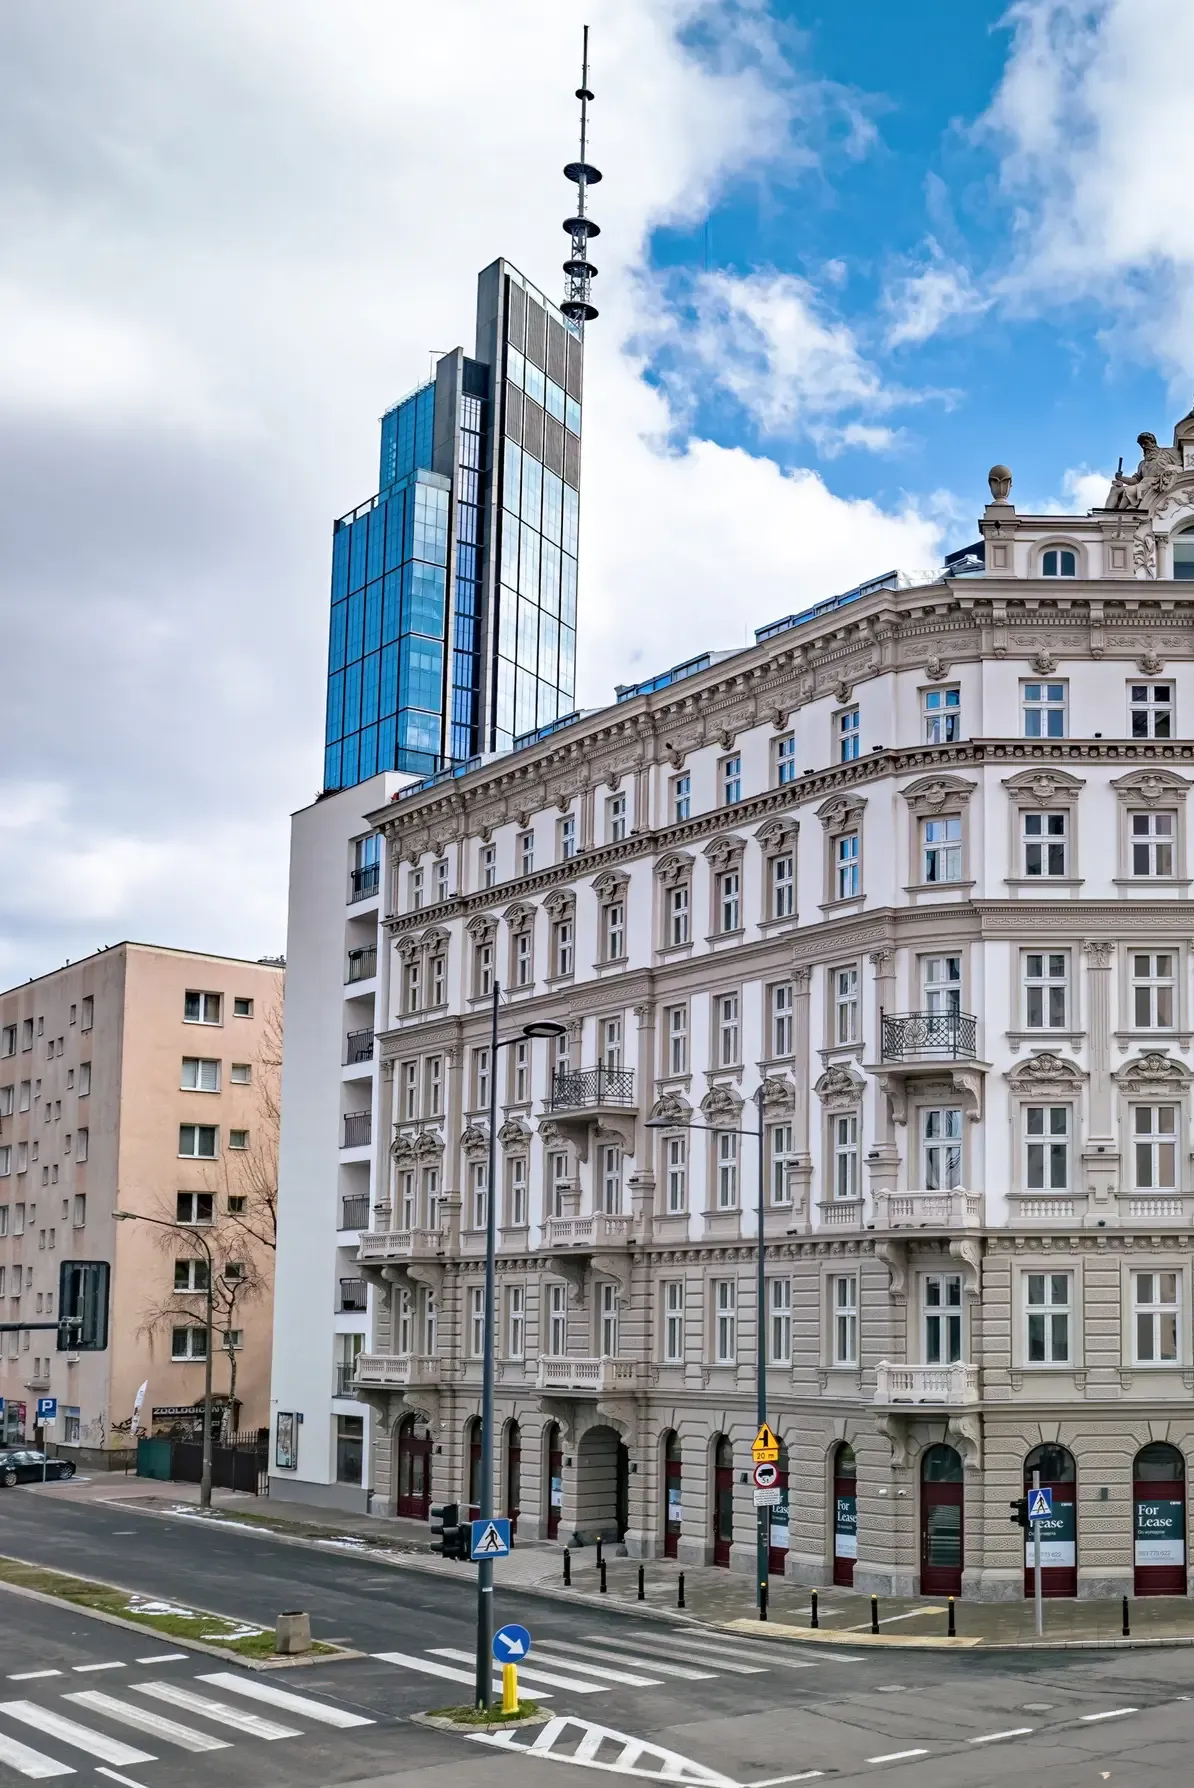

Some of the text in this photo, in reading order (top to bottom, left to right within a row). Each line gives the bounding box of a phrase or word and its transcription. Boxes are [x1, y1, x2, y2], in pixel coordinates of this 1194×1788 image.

[42, 1400, 53, 1412] P
[153, 1406, 226, 1415] ZOOLOGICNY
[838, 1500, 850, 1511] For
[1137, 1504, 1160, 1515] For
[1138, 1516, 1173, 1527] Lease
